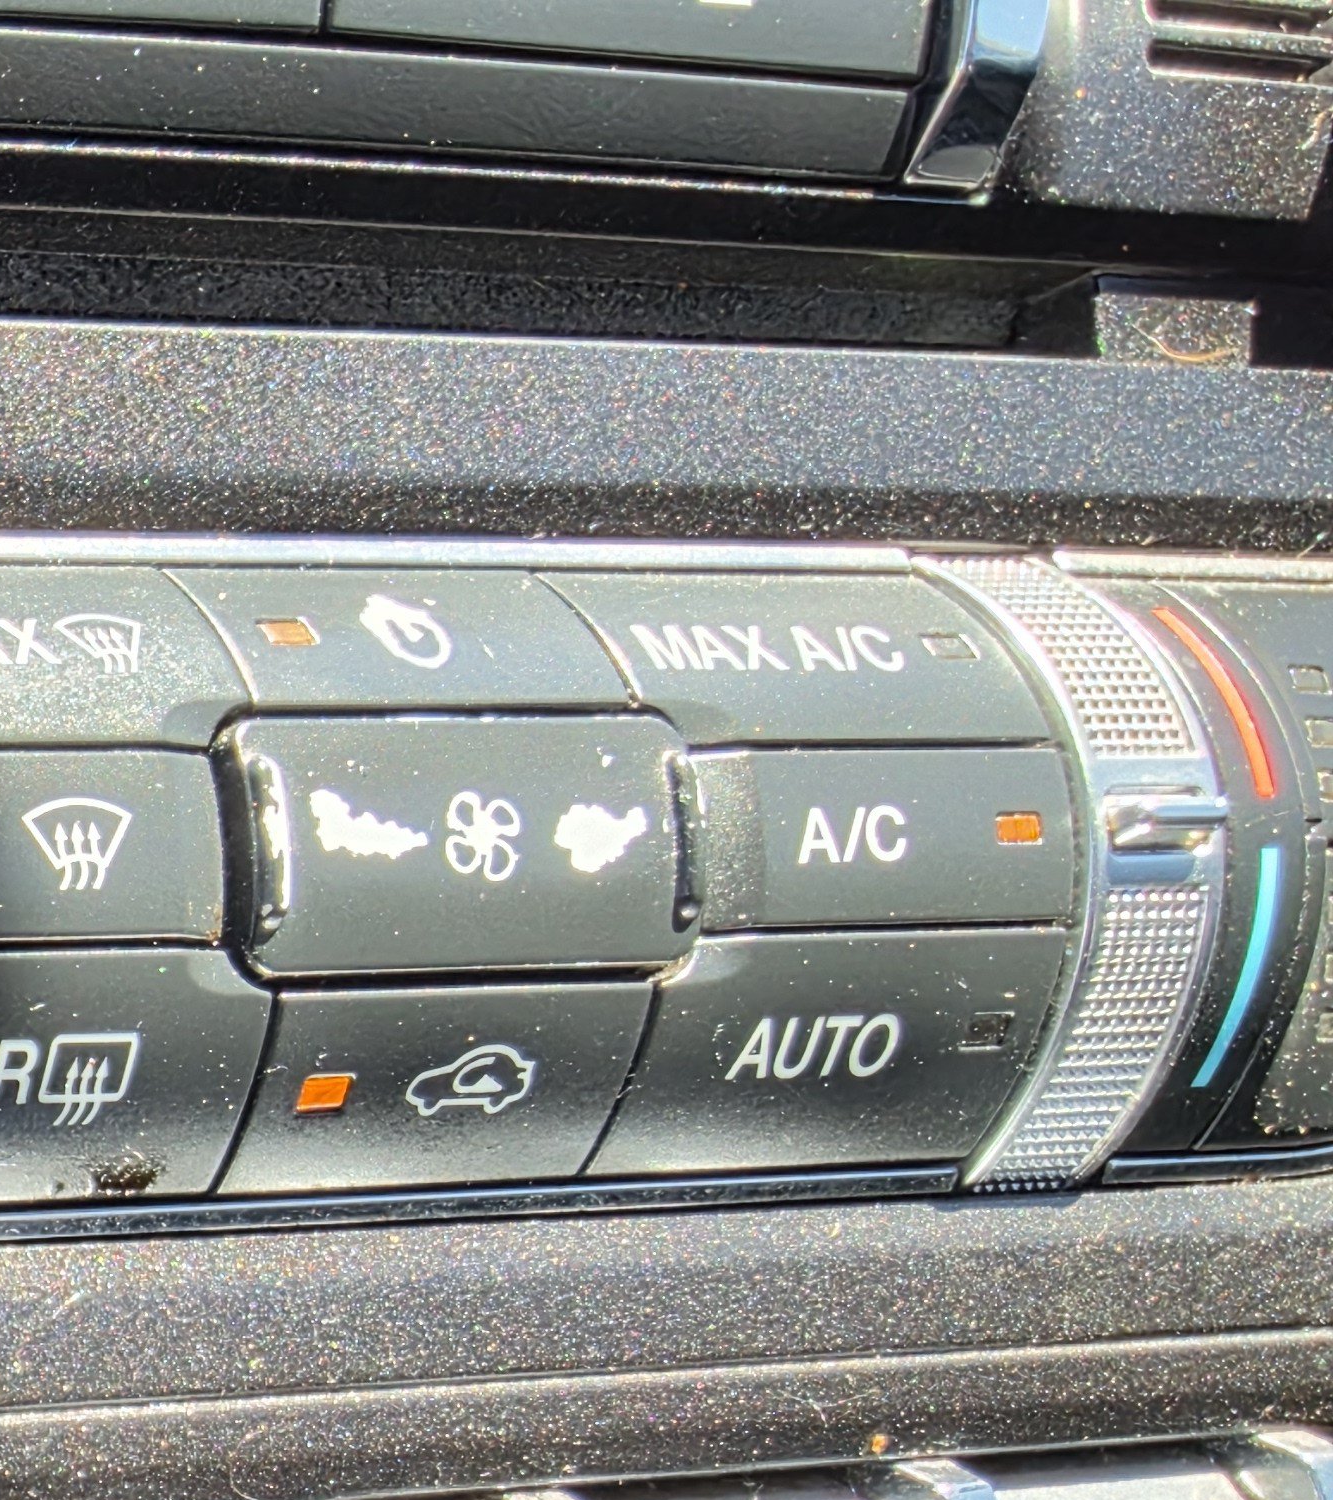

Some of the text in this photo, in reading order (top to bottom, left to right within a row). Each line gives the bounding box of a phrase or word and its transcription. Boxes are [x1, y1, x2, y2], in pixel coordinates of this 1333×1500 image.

[630, 624, 905, 672] MAX A/C
[798, 805, 908, 864] A/C
[725, 1013, 901, 1081] AUTO
